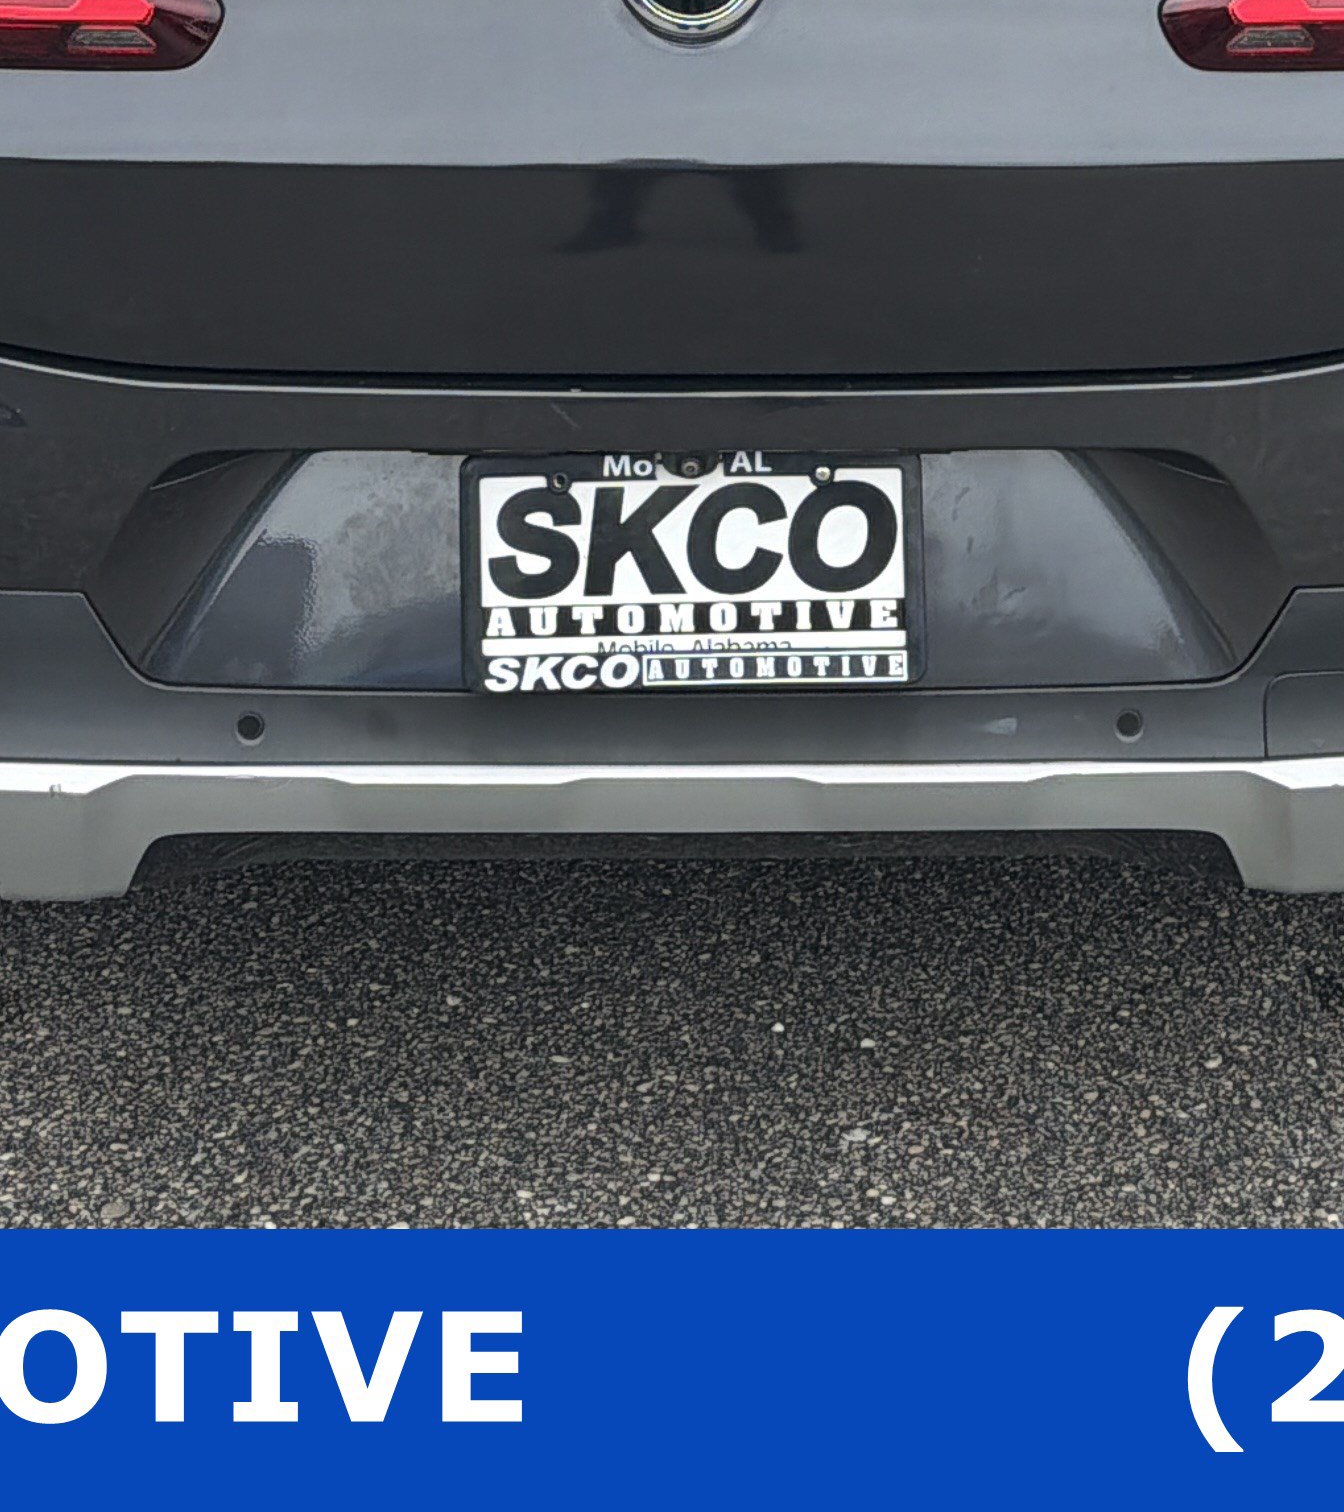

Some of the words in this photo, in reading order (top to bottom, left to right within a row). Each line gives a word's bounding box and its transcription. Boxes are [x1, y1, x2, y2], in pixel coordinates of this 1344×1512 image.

[729, 450, 772, 473] AL
[488, 480, 898, 600] SKCO
[485, 599, 900, 638] AUTOMOTIVE
[484, 654, 640, 692] SKCO
[647, 654, 905, 681] AUTOMOTIVE
